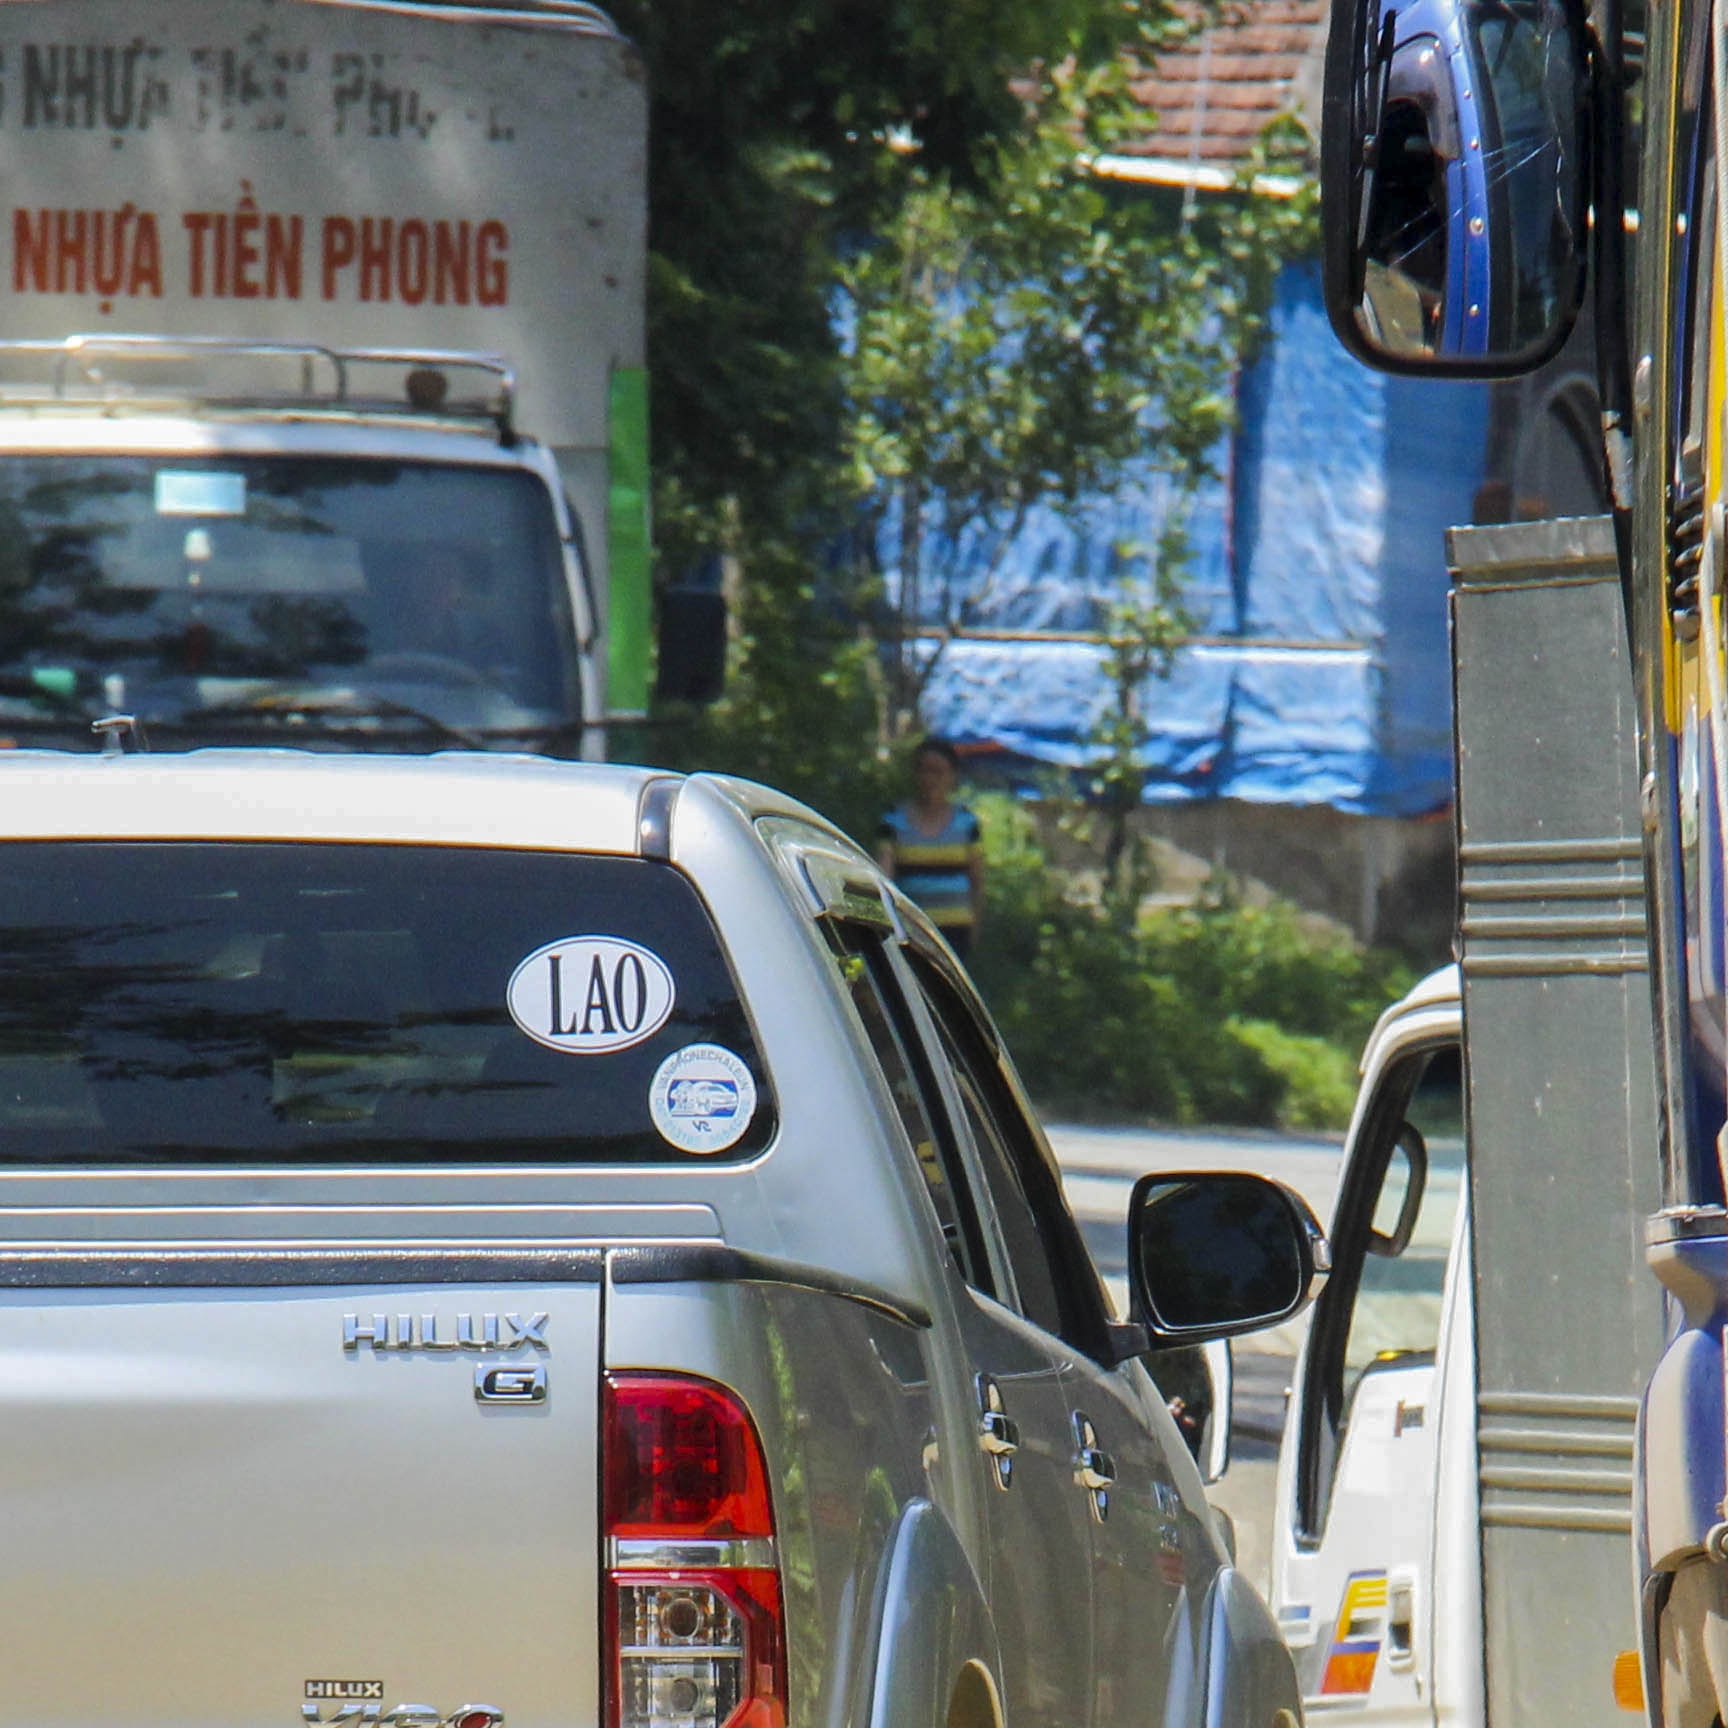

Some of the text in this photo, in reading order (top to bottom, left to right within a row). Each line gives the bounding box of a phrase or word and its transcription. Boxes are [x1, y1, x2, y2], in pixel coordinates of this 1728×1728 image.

[12, 202, 164, 314] NHỰA
[182, 178, 305, 299] TIỀN
[323, 215, 510, 307] PHONG
[547, 953, 648, 1037] LAO
[343, 1311, 551, 1353] HILUX
[477, 1363, 545, 1403] G
[306, 1681, 382, 1698] HILUX
